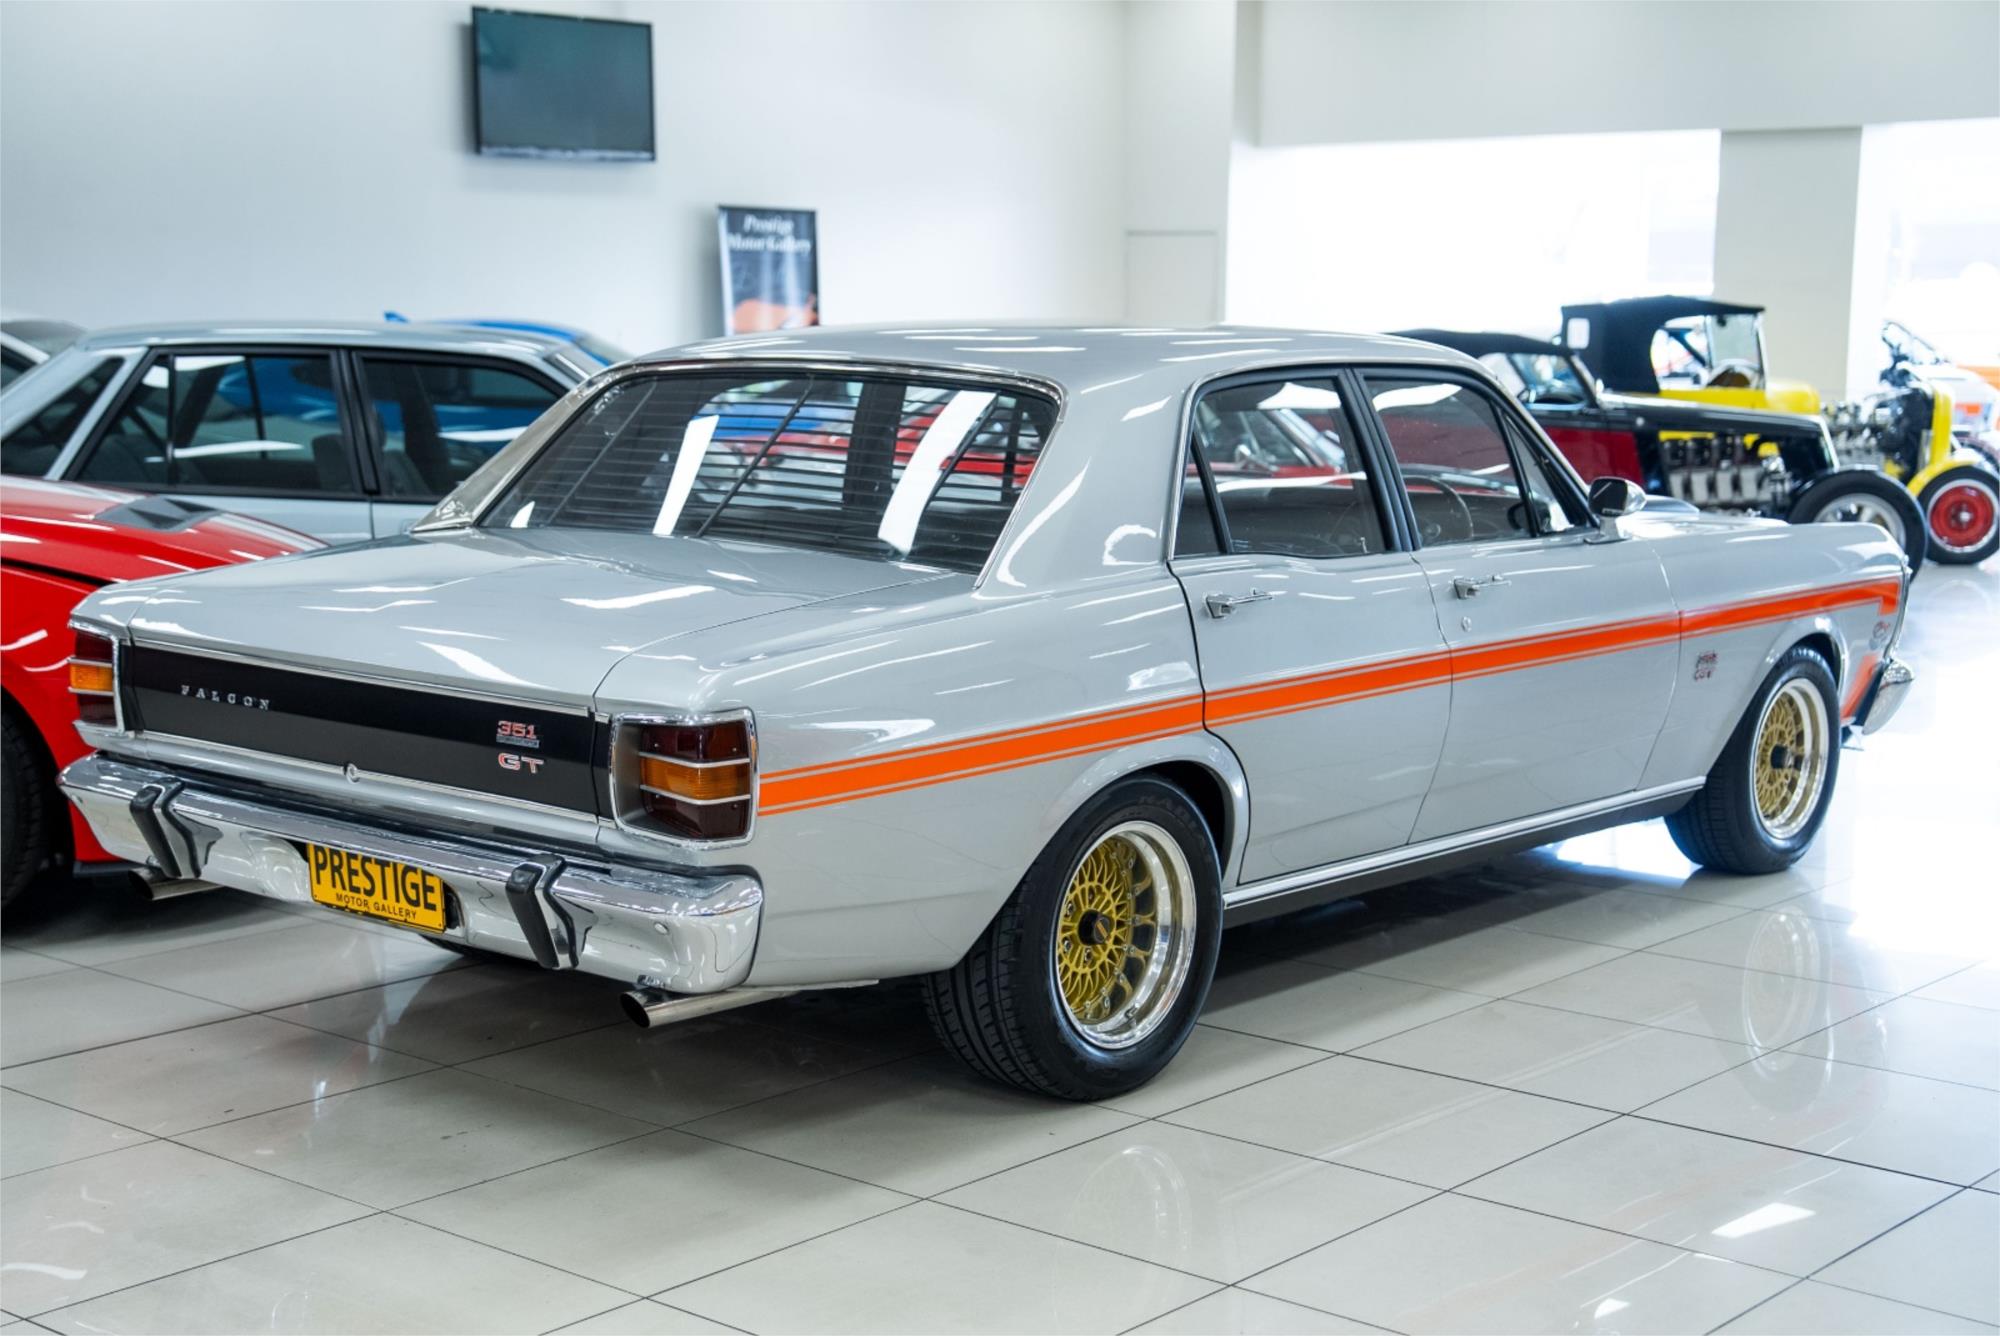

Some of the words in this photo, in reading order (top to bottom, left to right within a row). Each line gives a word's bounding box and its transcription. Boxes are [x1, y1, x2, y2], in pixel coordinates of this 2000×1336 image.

[181, 684, 270, 710] FALCON
[497, 720, 537, 739] 351
[498, 752, 544, 773] GT
[313, 845, 437, 911] PRESTIGE
[335, 893, 369, 908] MOTOR
[373, 901, 417, 919] GALLERY
